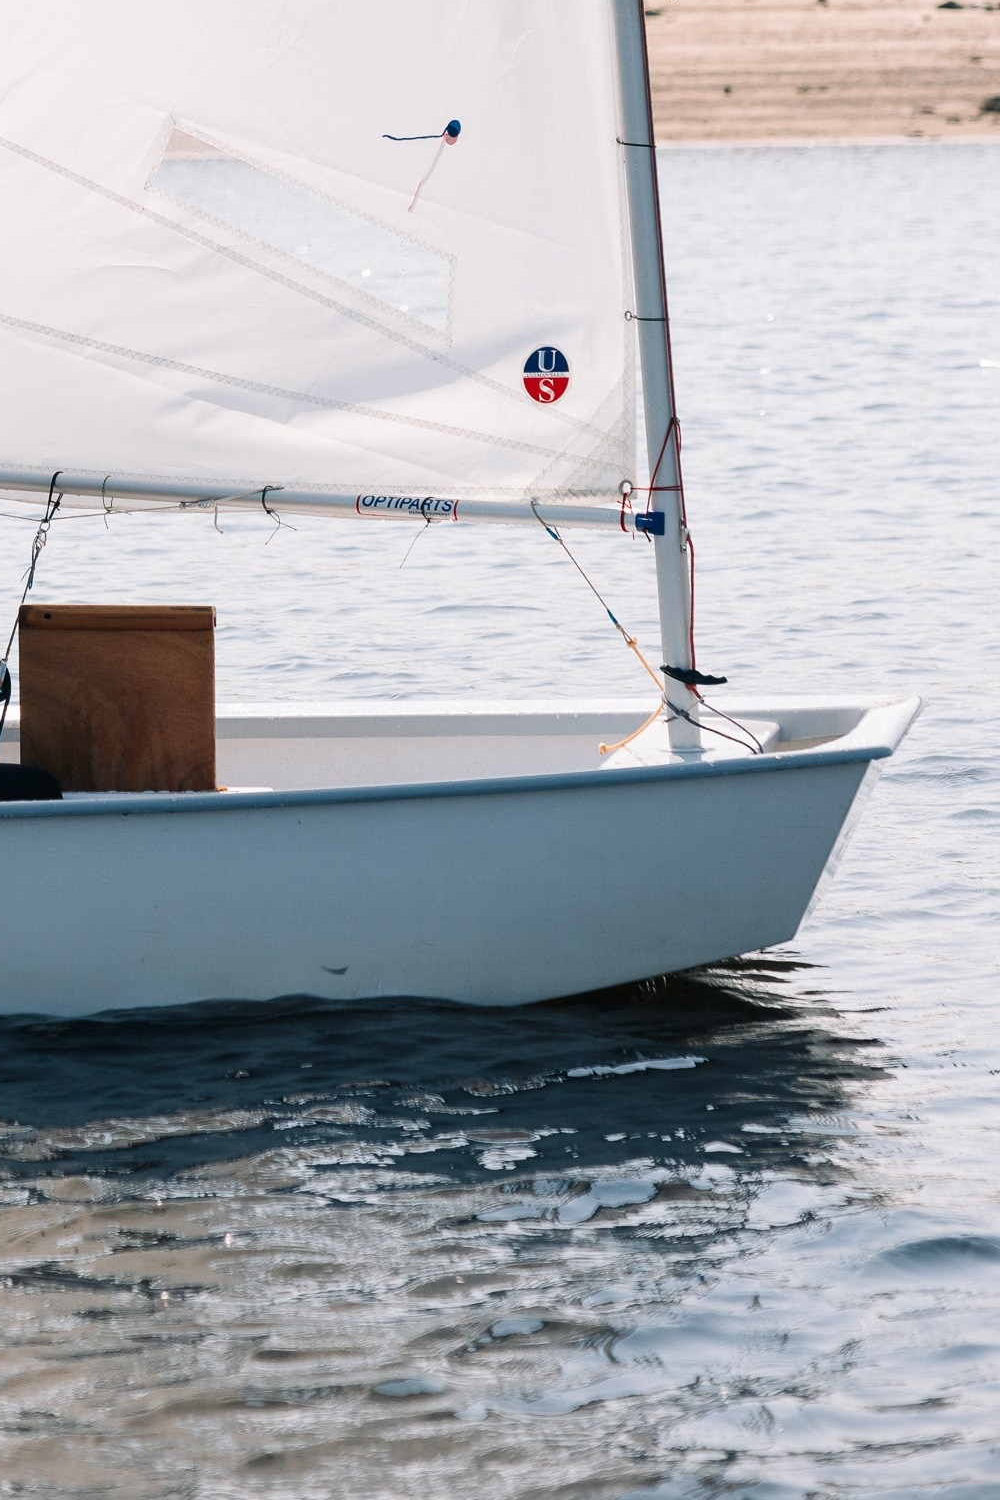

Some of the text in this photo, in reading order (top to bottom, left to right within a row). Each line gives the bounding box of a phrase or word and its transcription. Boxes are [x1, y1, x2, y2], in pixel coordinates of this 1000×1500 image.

[537, 349, 558, 373] U
[538, 378, 556, 403] S
[362, 495, 455, 512] OPTIPARTS
